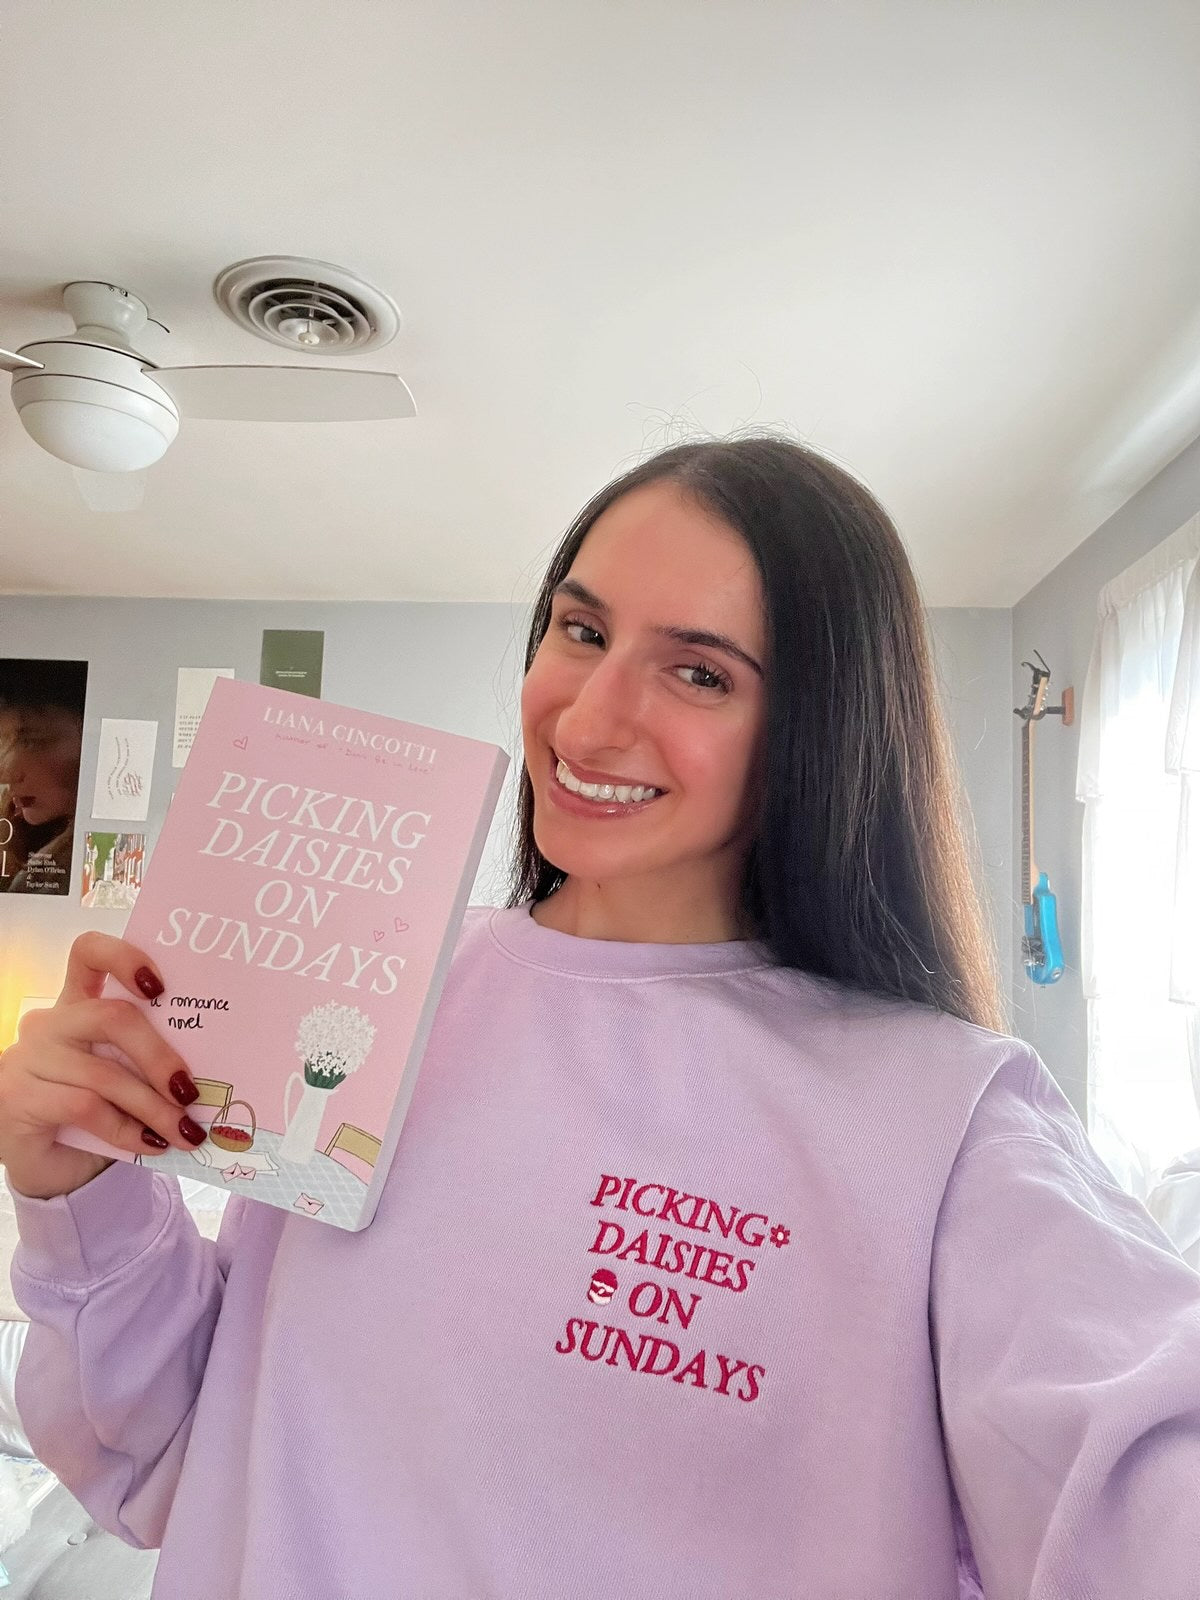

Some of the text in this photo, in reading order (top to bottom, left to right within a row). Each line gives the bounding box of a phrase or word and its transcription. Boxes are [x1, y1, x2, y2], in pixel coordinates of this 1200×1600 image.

[264, 707, 436, 763] LIANA CINCOTTI
[206, 771, 432, 849] PICKING
[199, 818, 412, 895] DAISIES
[254, 880, 340, 928] ON
[156, 907, 407, 995] SUNDAYS
[168, 1013, 203, 1029] novel
[170, 996, 229, 1011] romance
[590, 1174, 768, 1247] PICKING
[588, 1220, 756, 1293] DAISIES
[628, 1281, 702, 1330] ON
[555, 1317, 765, 1402] SUNDAYS
